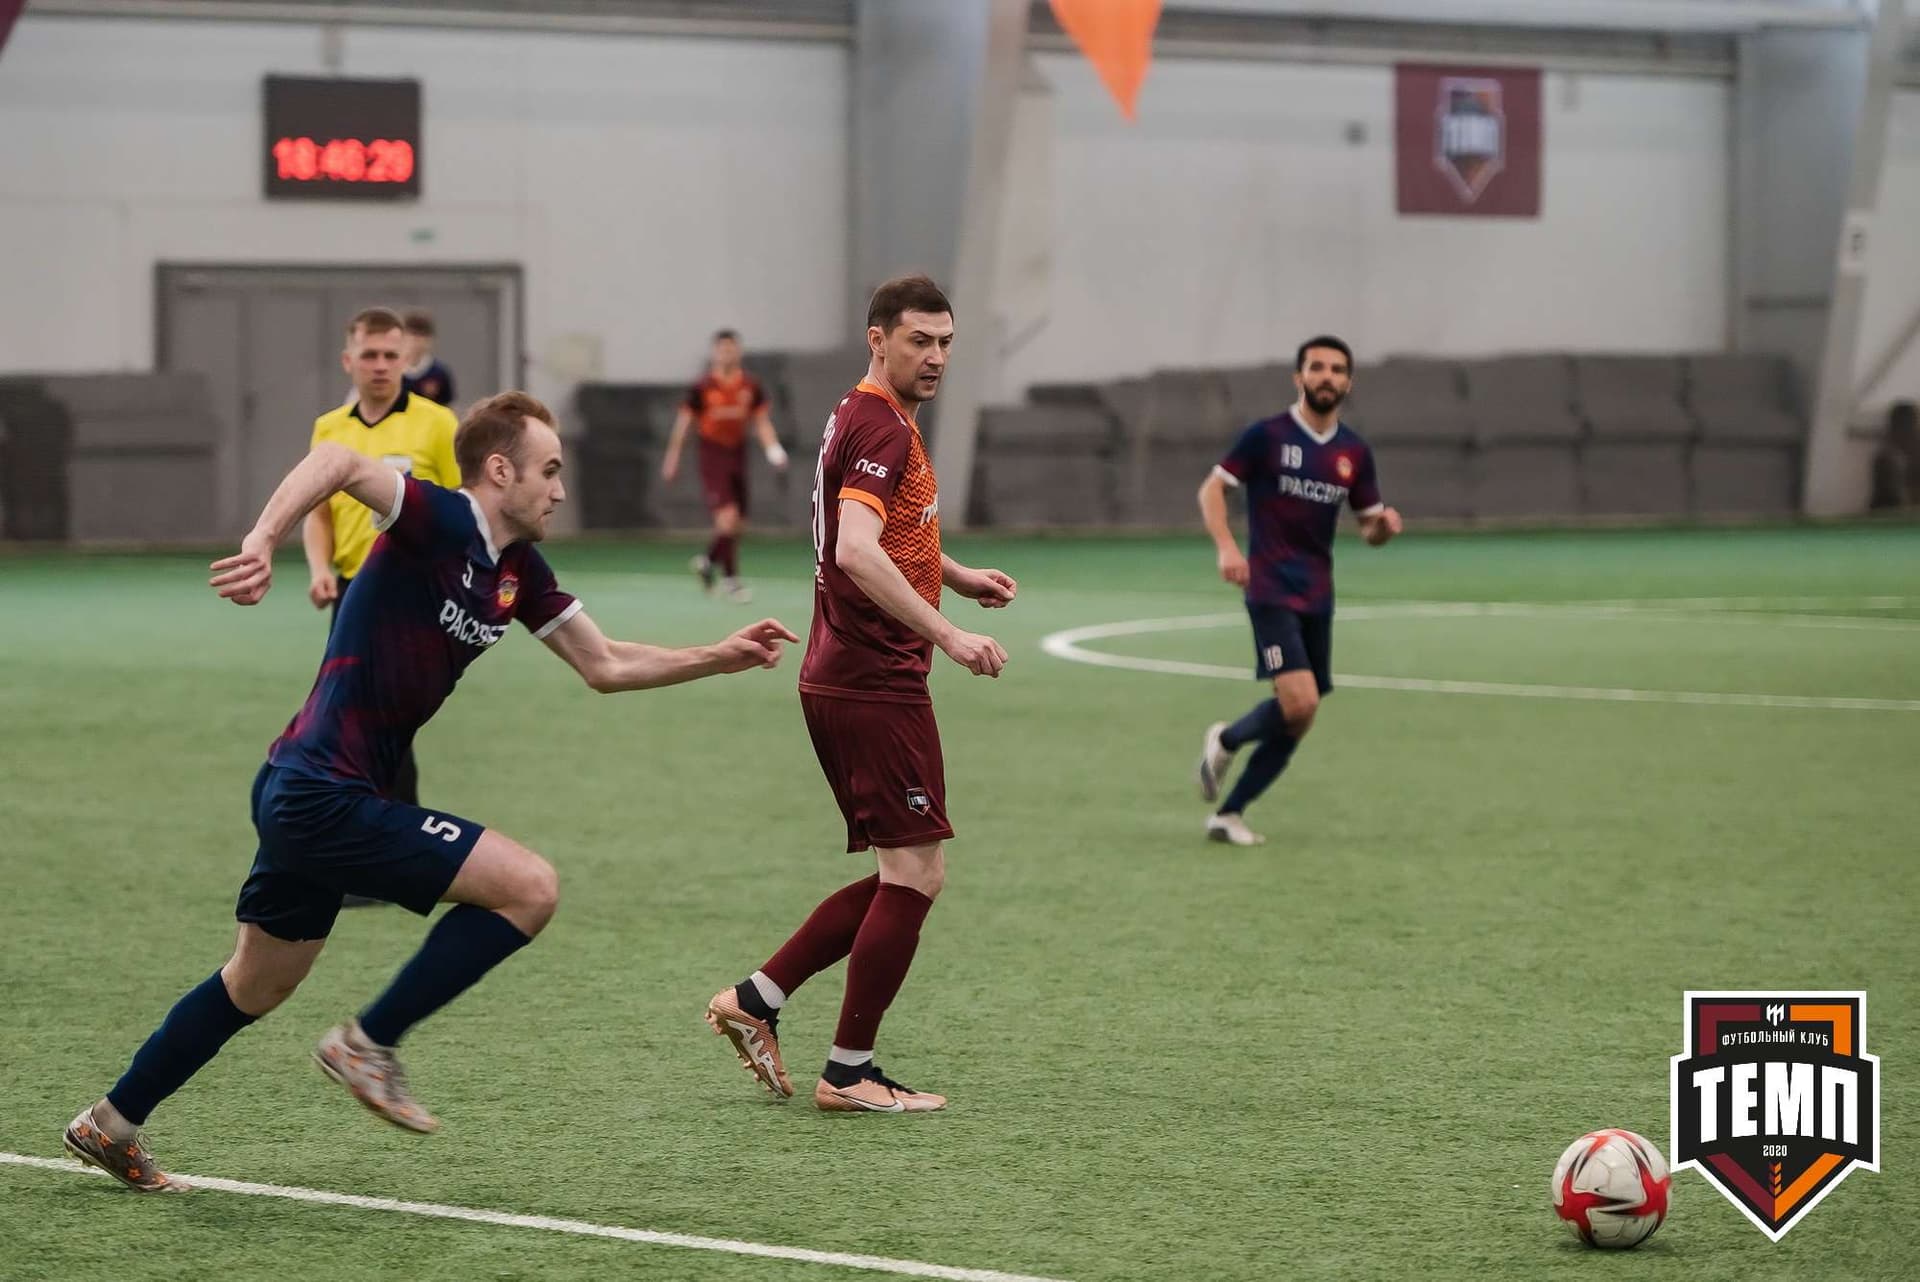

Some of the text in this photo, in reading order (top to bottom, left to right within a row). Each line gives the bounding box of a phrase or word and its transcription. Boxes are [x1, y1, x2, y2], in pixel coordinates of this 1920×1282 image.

[855, 458, 888, 479] ПСБ
[1280, 443, 1303, 470] 19
[421, 815, 461, 842] 5
